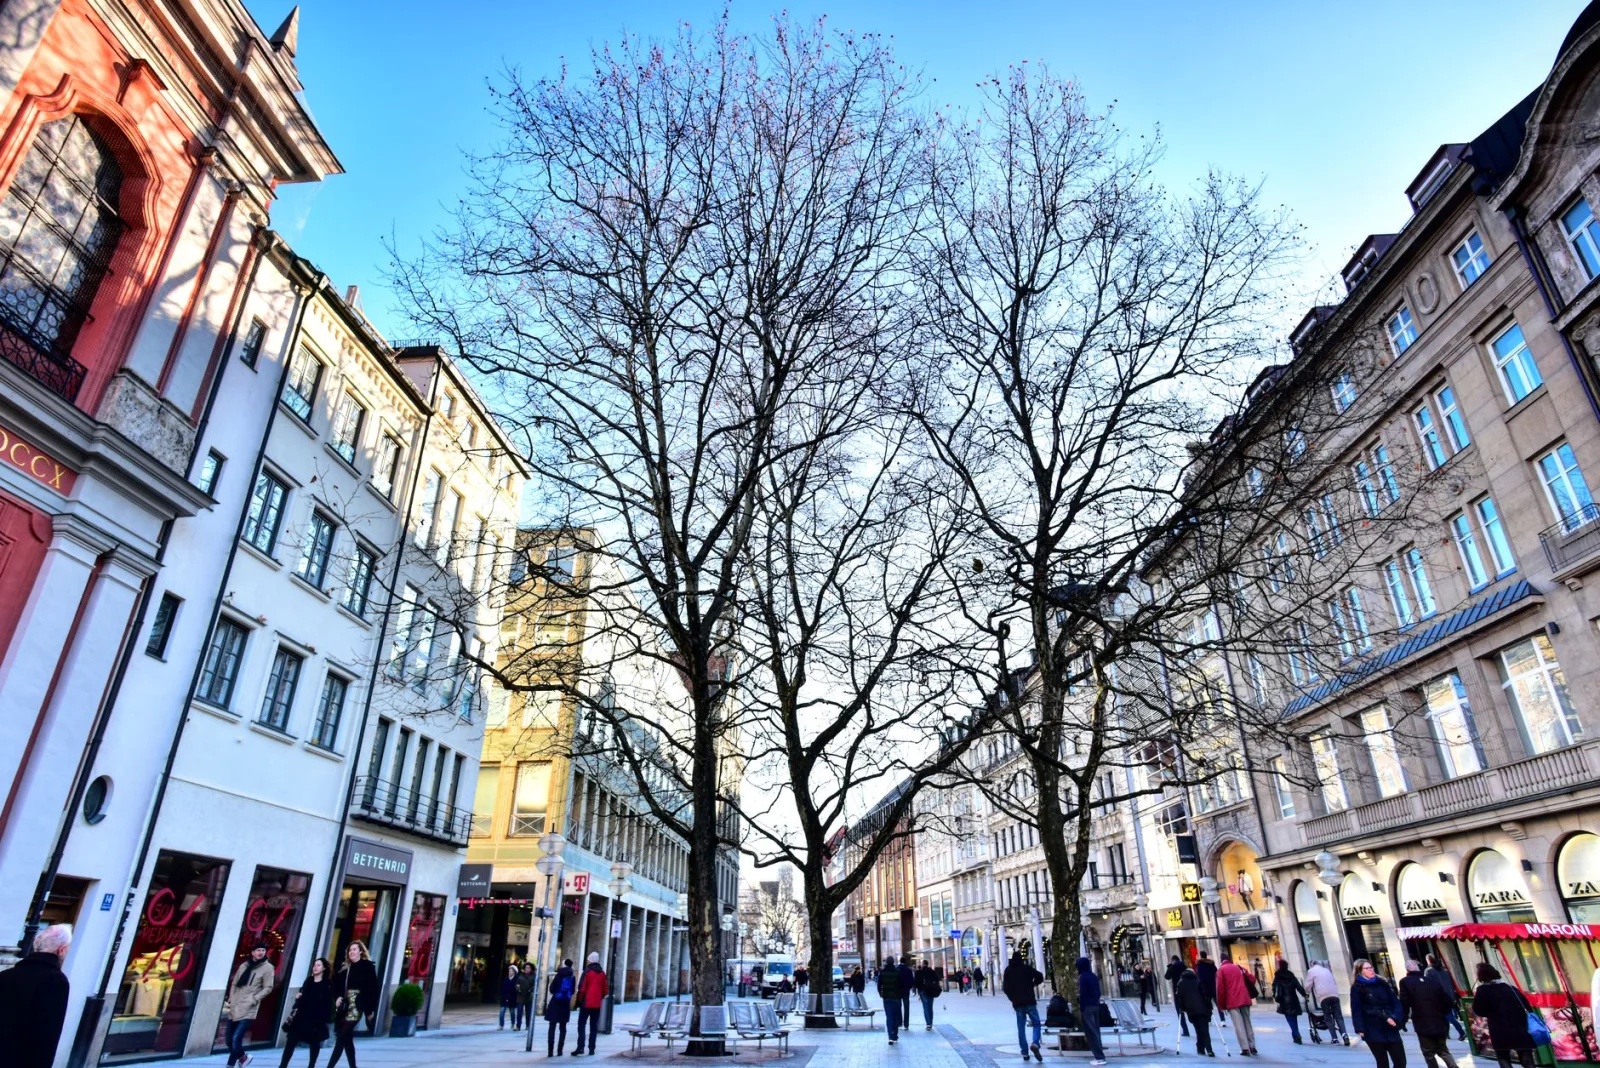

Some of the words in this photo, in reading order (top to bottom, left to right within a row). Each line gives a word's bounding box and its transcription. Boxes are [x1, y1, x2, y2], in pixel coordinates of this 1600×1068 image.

[353, 852, 407, 874] BETTENRID
[1568, 881, 1600, 895] ZA
[1476, 889, 1525, 904] ZARA
[1344, 905, 1377, 916] ZARA
[1403, 898, 1442, 911] ZARA
[1525, 923, 1592, 936] MARONI
